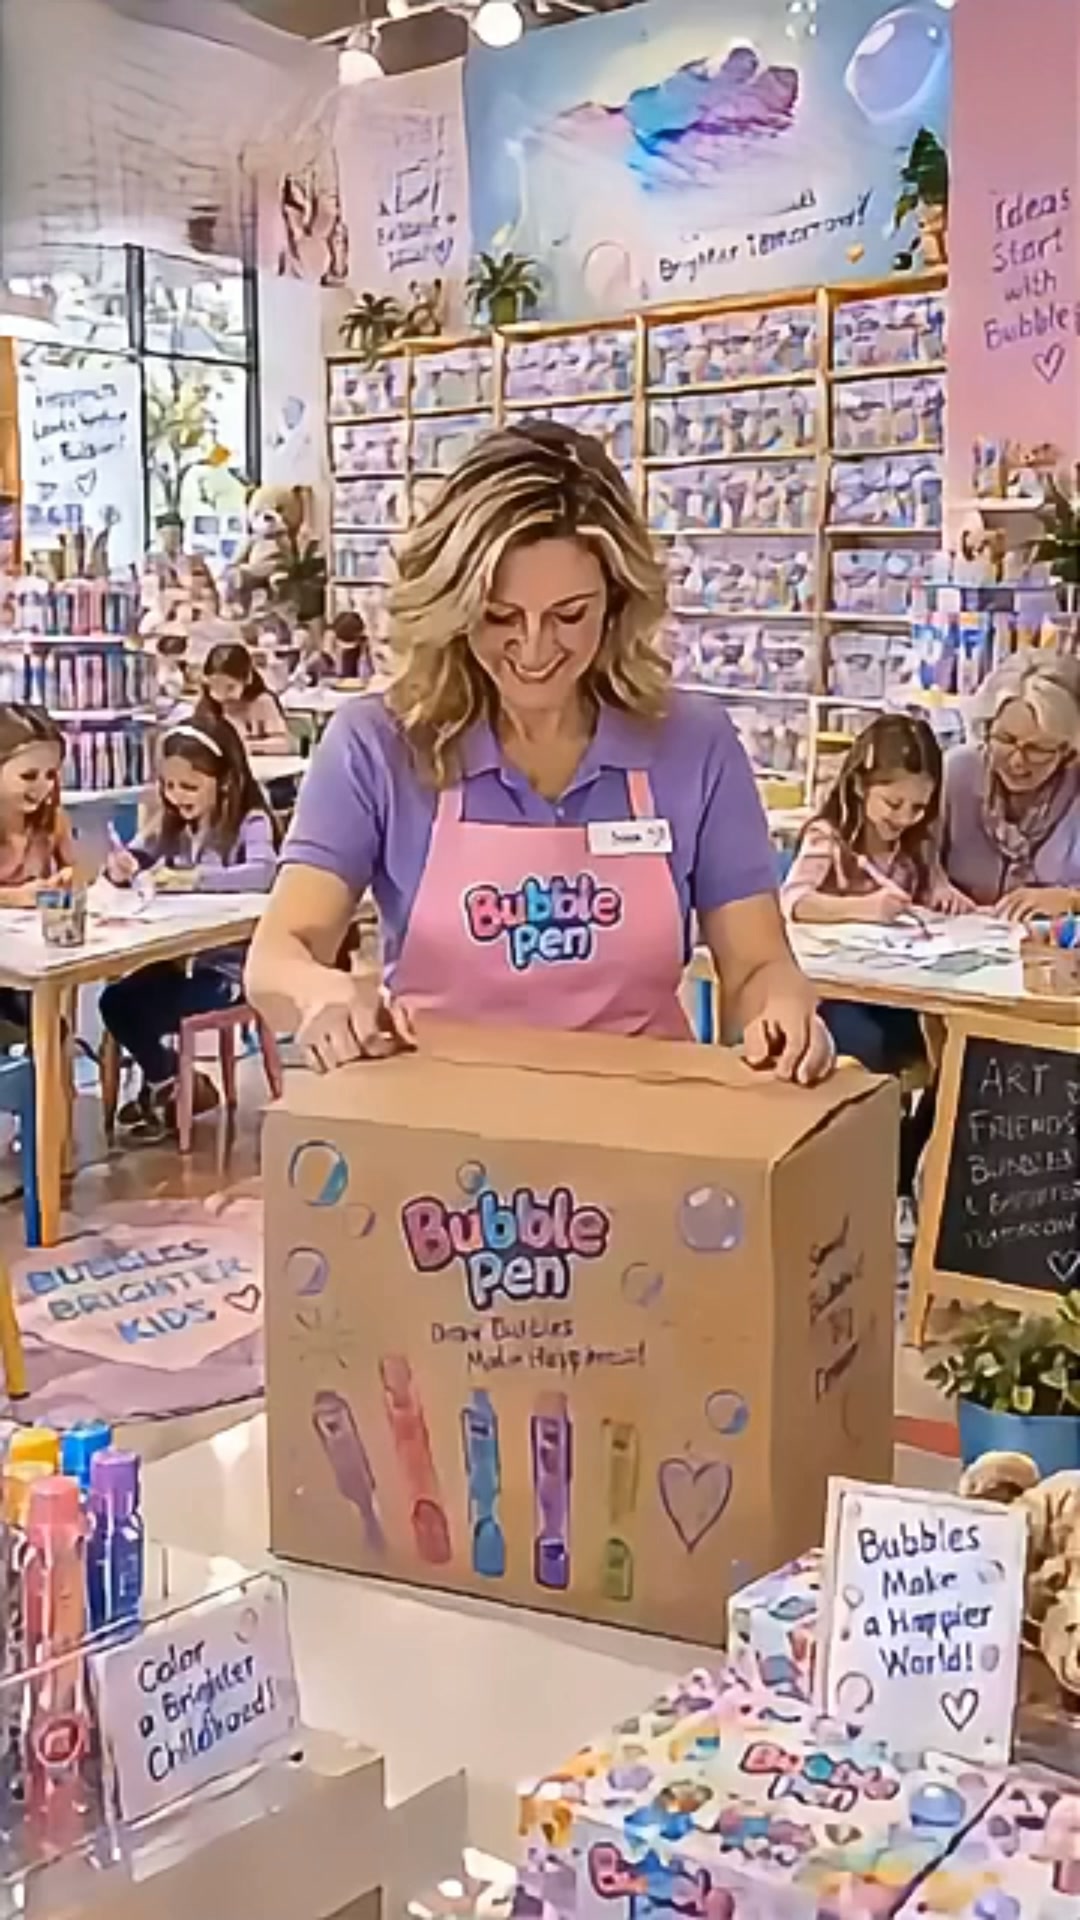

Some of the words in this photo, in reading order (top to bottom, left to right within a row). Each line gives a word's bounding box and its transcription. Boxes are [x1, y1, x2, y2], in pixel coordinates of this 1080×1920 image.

[995, 187, 1070, 231] Ideas
[992, 227, 1062, 273] Start
[1004, 269, 1056, 301] with
[465, 873, 622, 942] Bubble
[980, 1058, 1050, 1097] ART
[402, 1187, 609, 1272] Bubble
[857, 1518, 980, 1564] Bubbles
[863, 1615, 881, 1637] a
[138, 1640, 205, 1692] Color
[879, 1642, 973, 1679] World!
